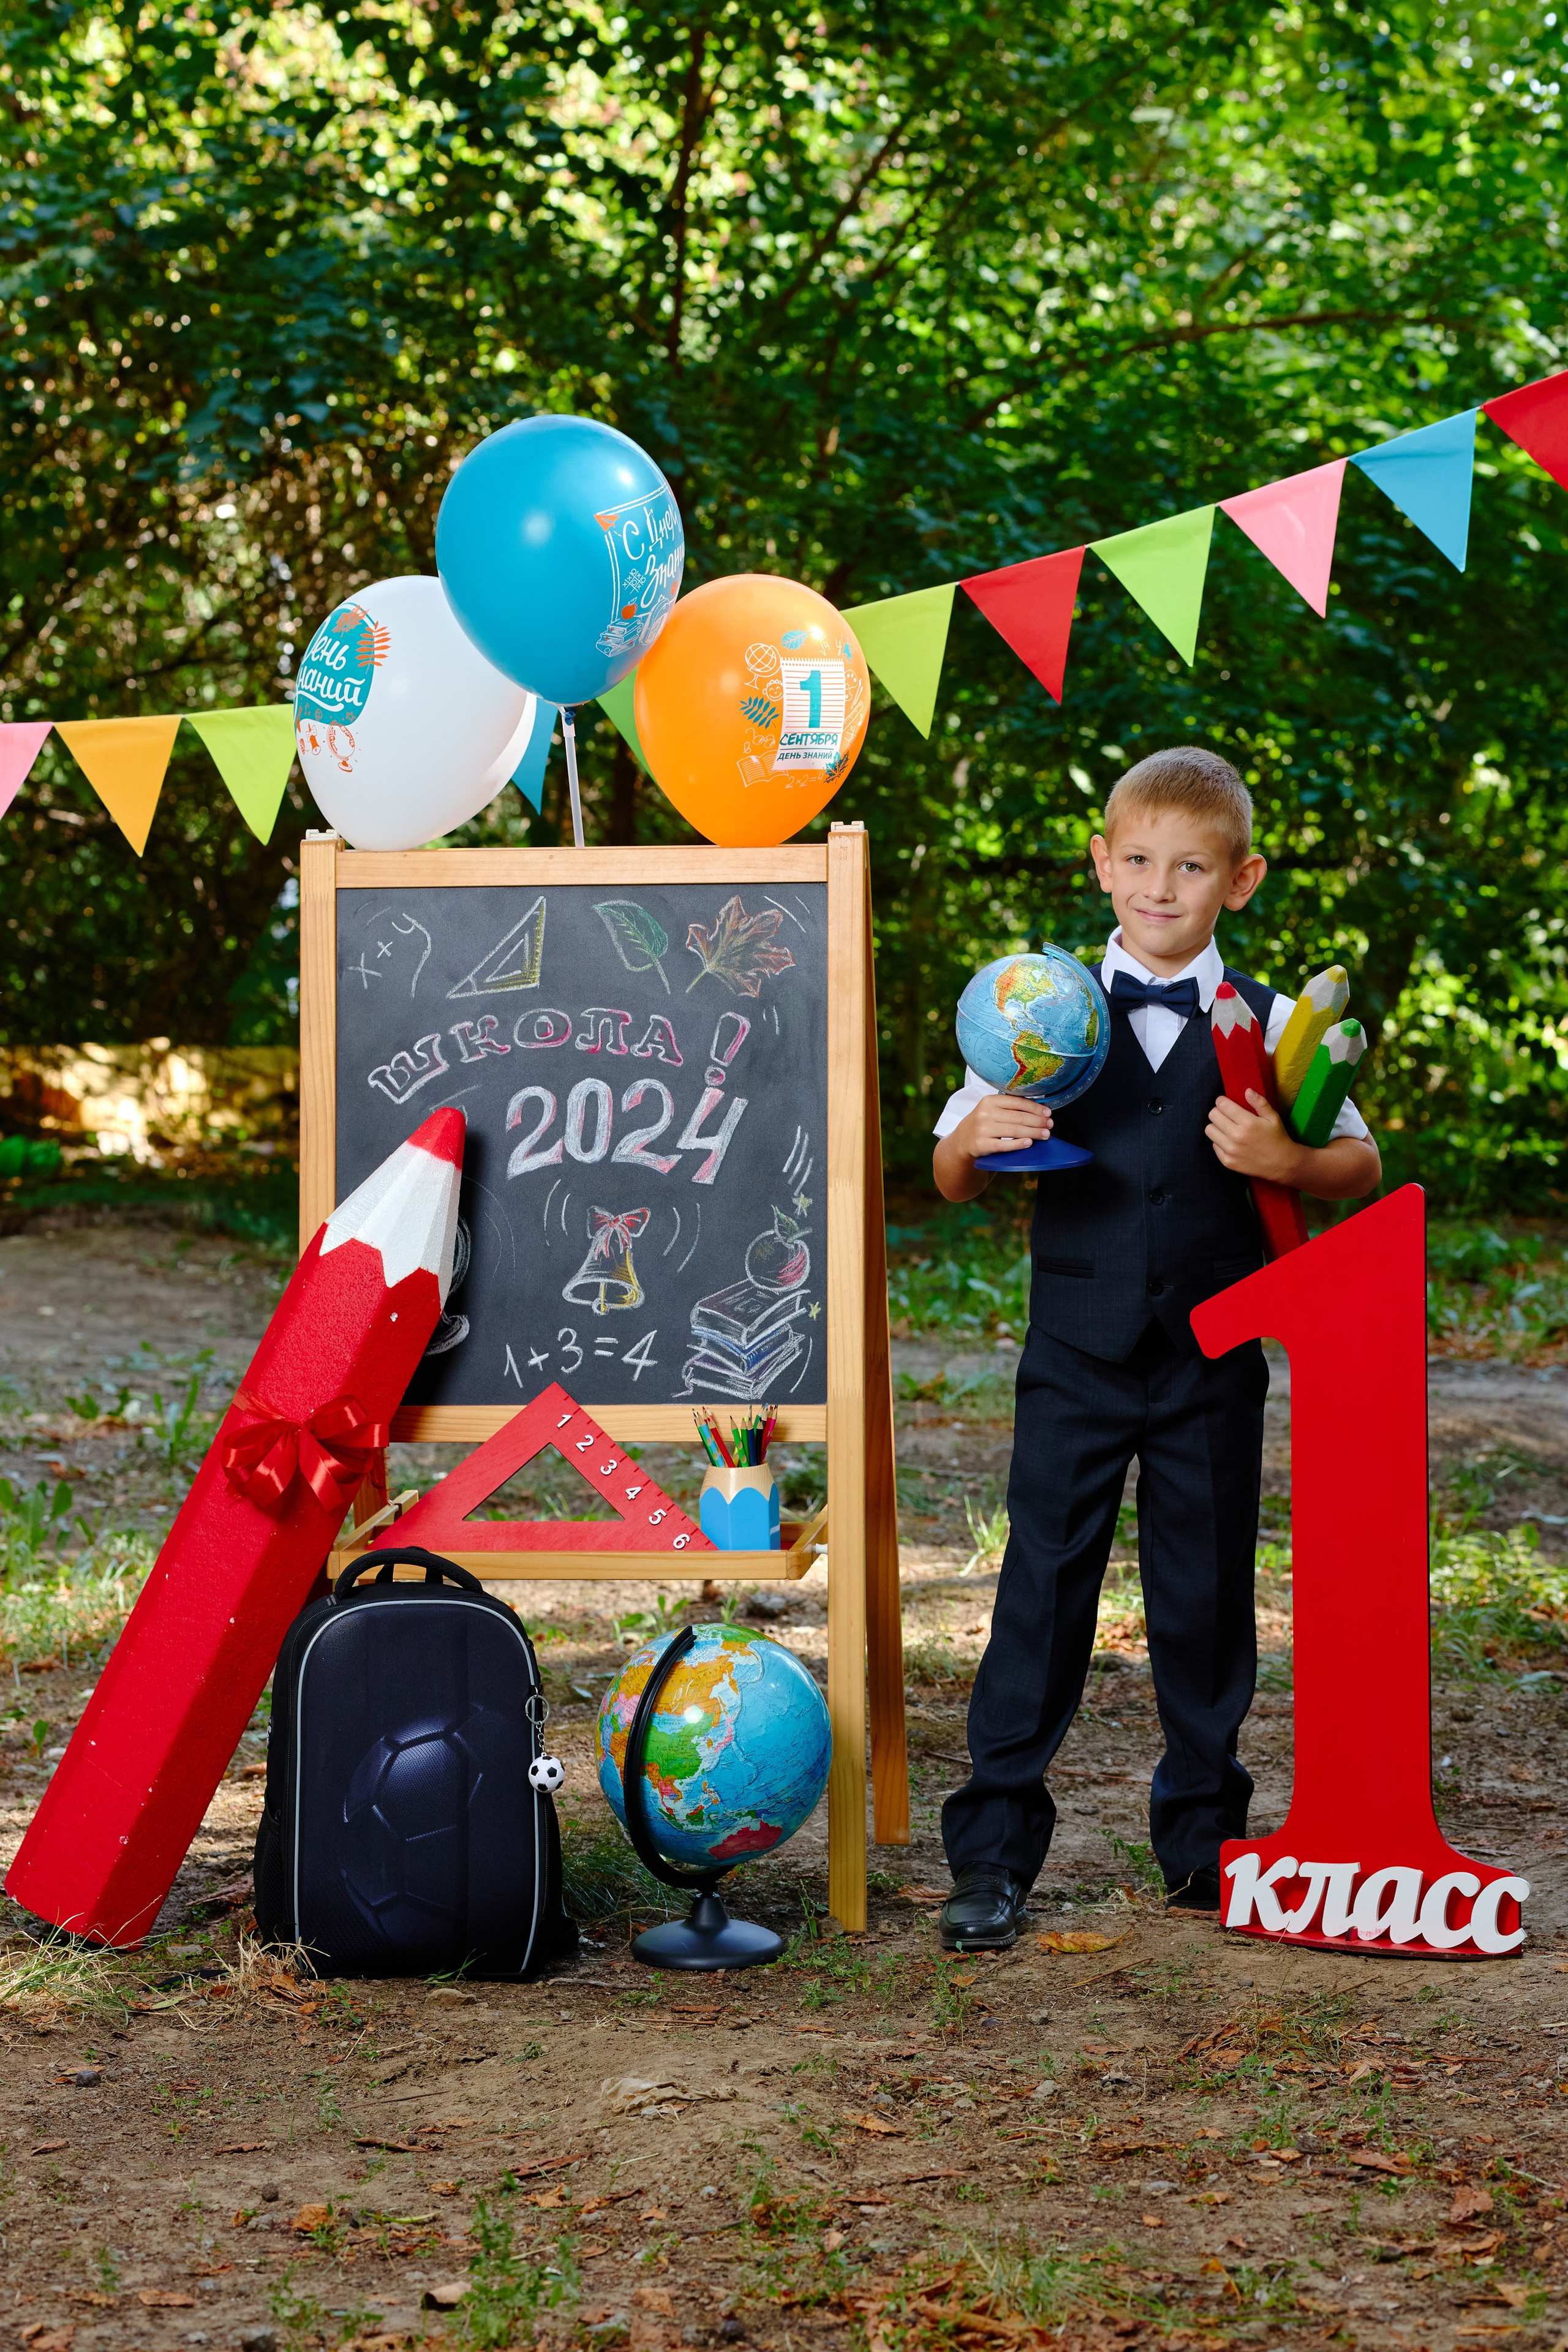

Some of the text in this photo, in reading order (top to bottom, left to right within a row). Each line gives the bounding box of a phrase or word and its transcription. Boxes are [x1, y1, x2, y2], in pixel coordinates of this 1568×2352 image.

[623, 521, 644, 560] С
[293, 665, 366, 712] наний
[799, 669, 822, 729] 1
[777, 751, 833, 761] ДЕНЬ ЗНАНИЙ
[779, 732, 839, 747] СЕНТЯБРЯ
[505, 1077, 749, 1186] 2024
[556, 1414, 692, 1550] 1 2 3 4 5 6
